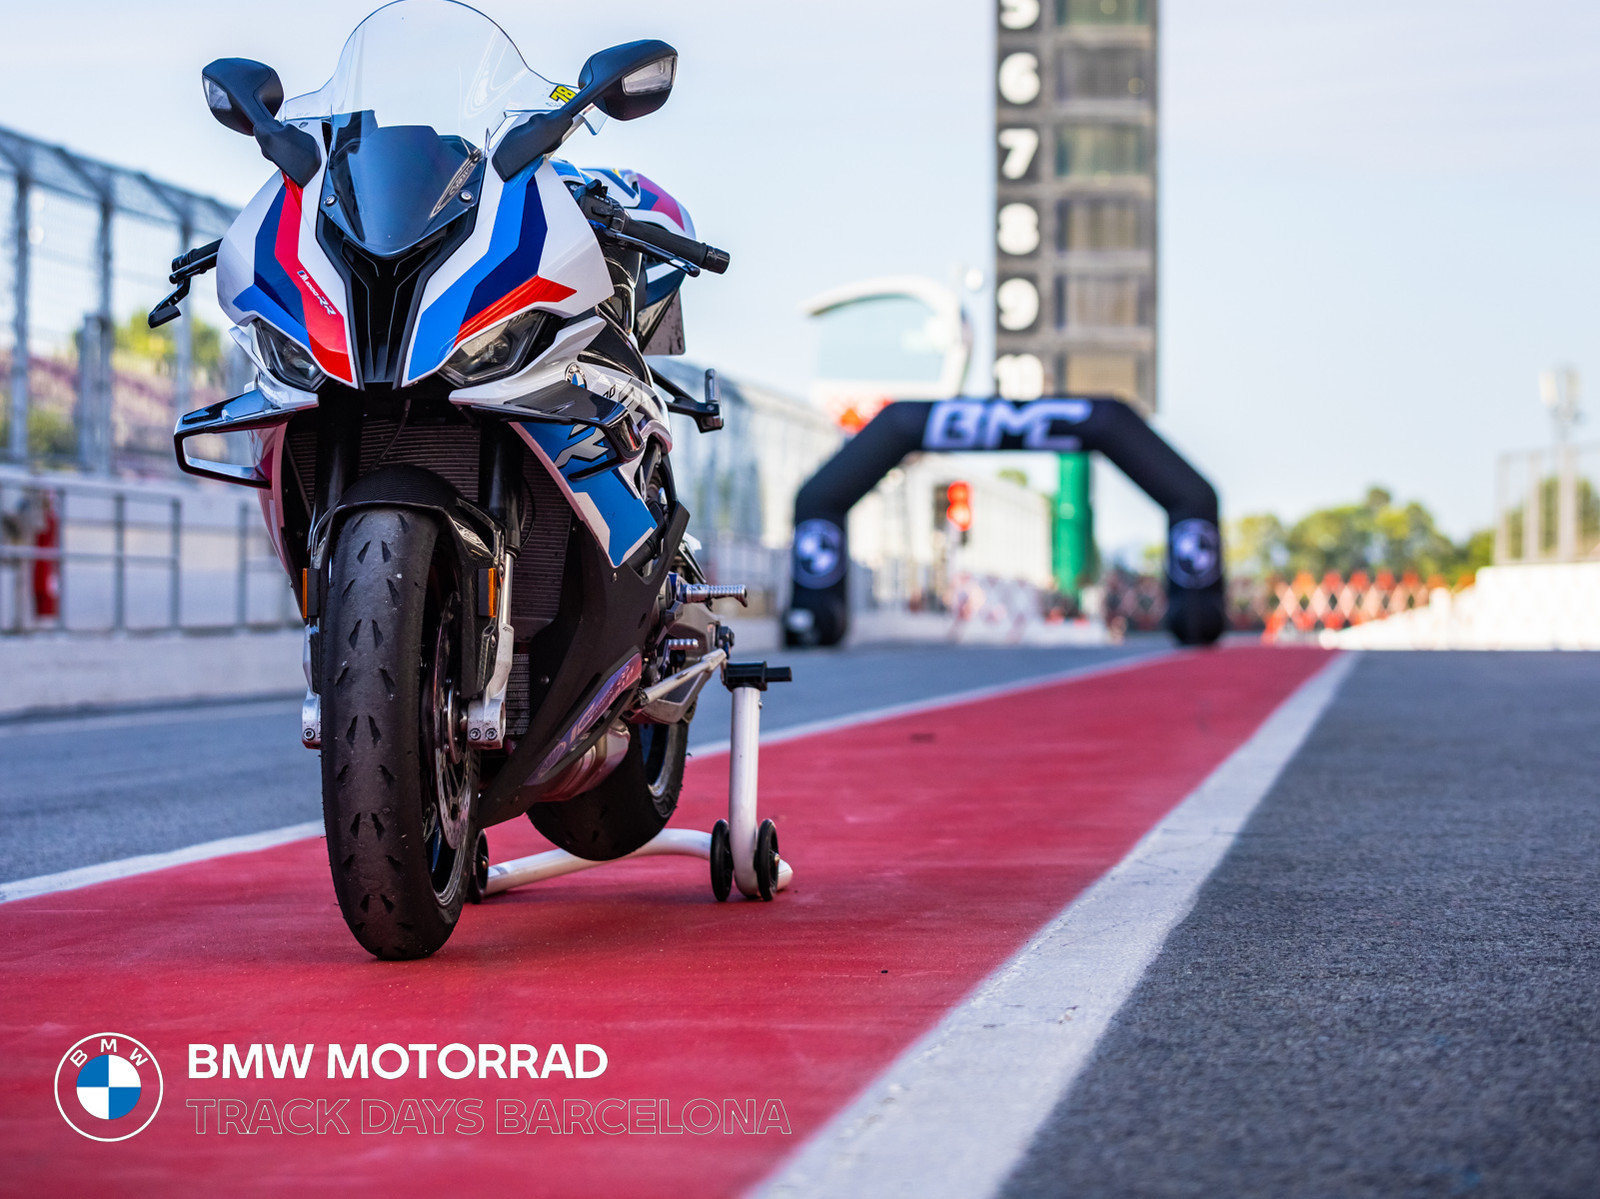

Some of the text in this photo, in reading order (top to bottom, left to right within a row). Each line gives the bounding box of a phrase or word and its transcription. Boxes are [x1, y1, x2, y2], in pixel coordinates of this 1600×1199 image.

[998, 51, 1040, 104] 6
[998, 128, 1039, 179] 7
[997, 277, 1039, 330] 9
